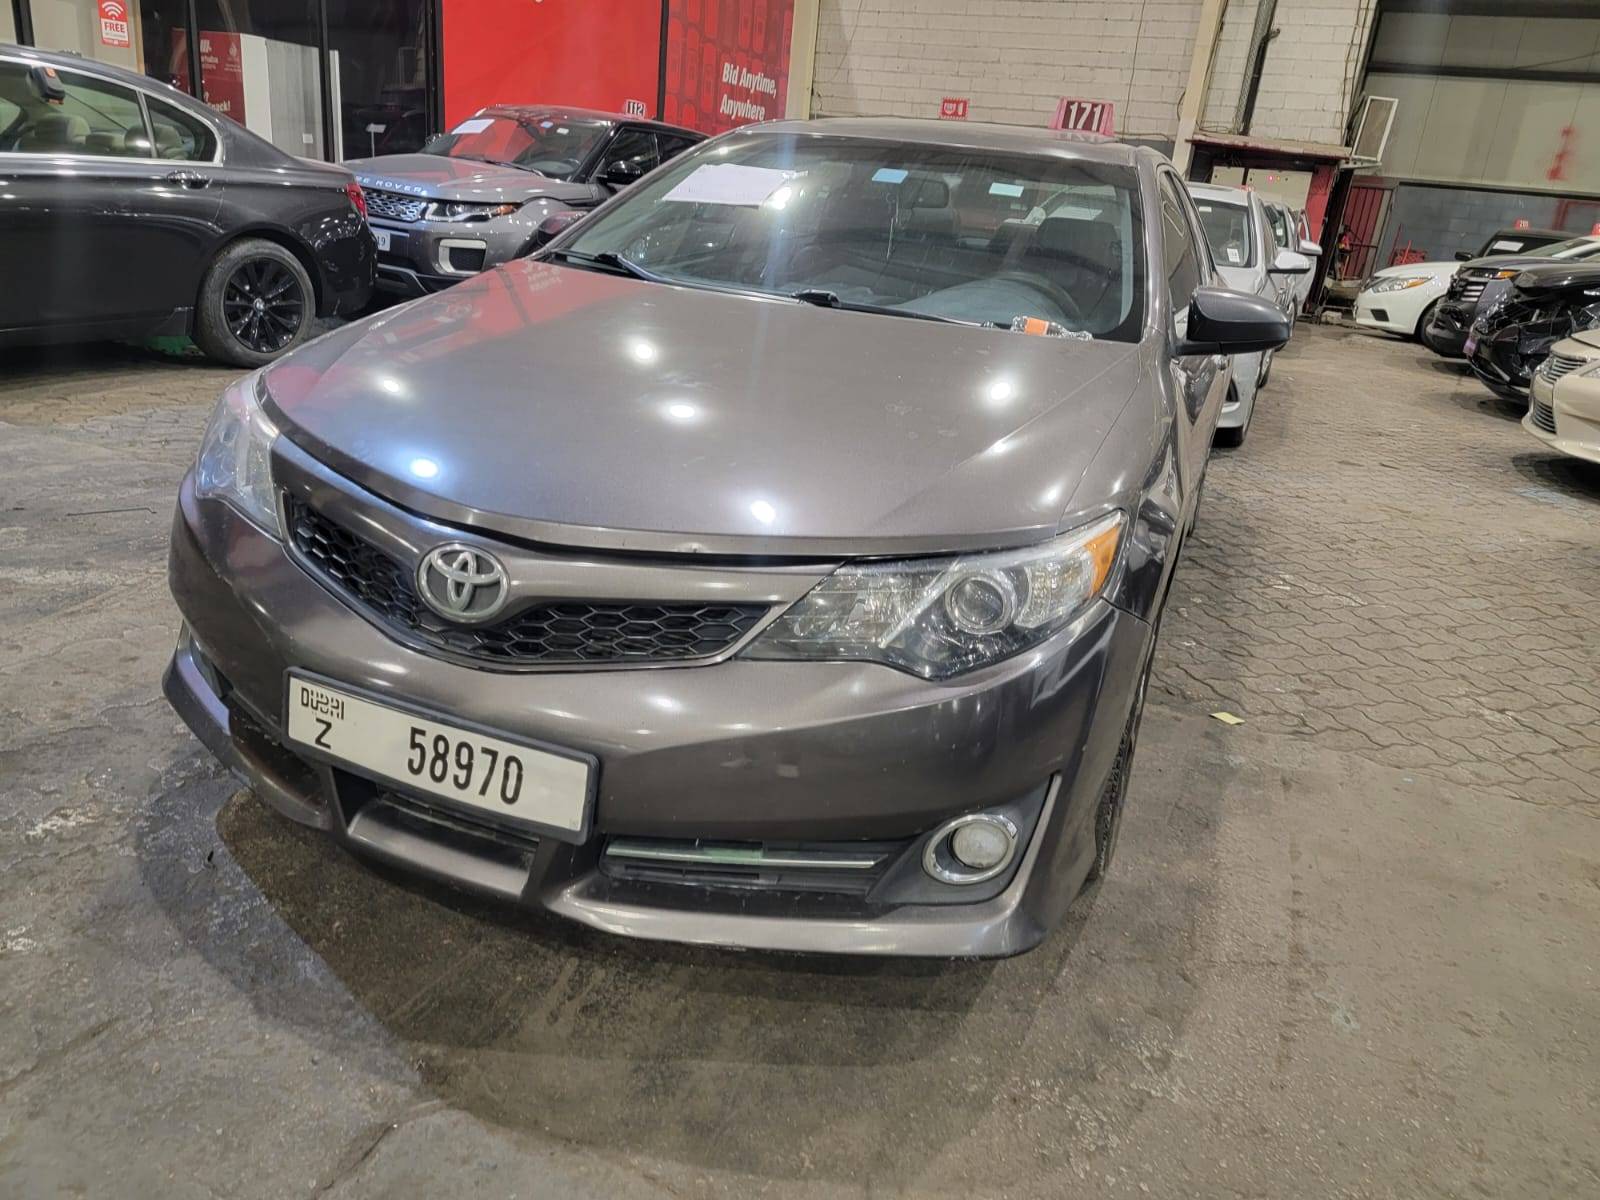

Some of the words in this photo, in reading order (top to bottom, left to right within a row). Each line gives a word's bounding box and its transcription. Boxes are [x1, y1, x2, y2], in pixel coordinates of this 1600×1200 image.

[104, 21, 125, 32] FREE
[722, 62, 739, 86] Bid
[739, 67, 776, 99] Anytime,
[720, 94, 765, 121] Anywhere
[1068, 101, 1102, 132] 171
[376, 180, 422, 192] ROVER
[315, 717, 332, 749] Z
[408, 726, 523, 805] 58970
